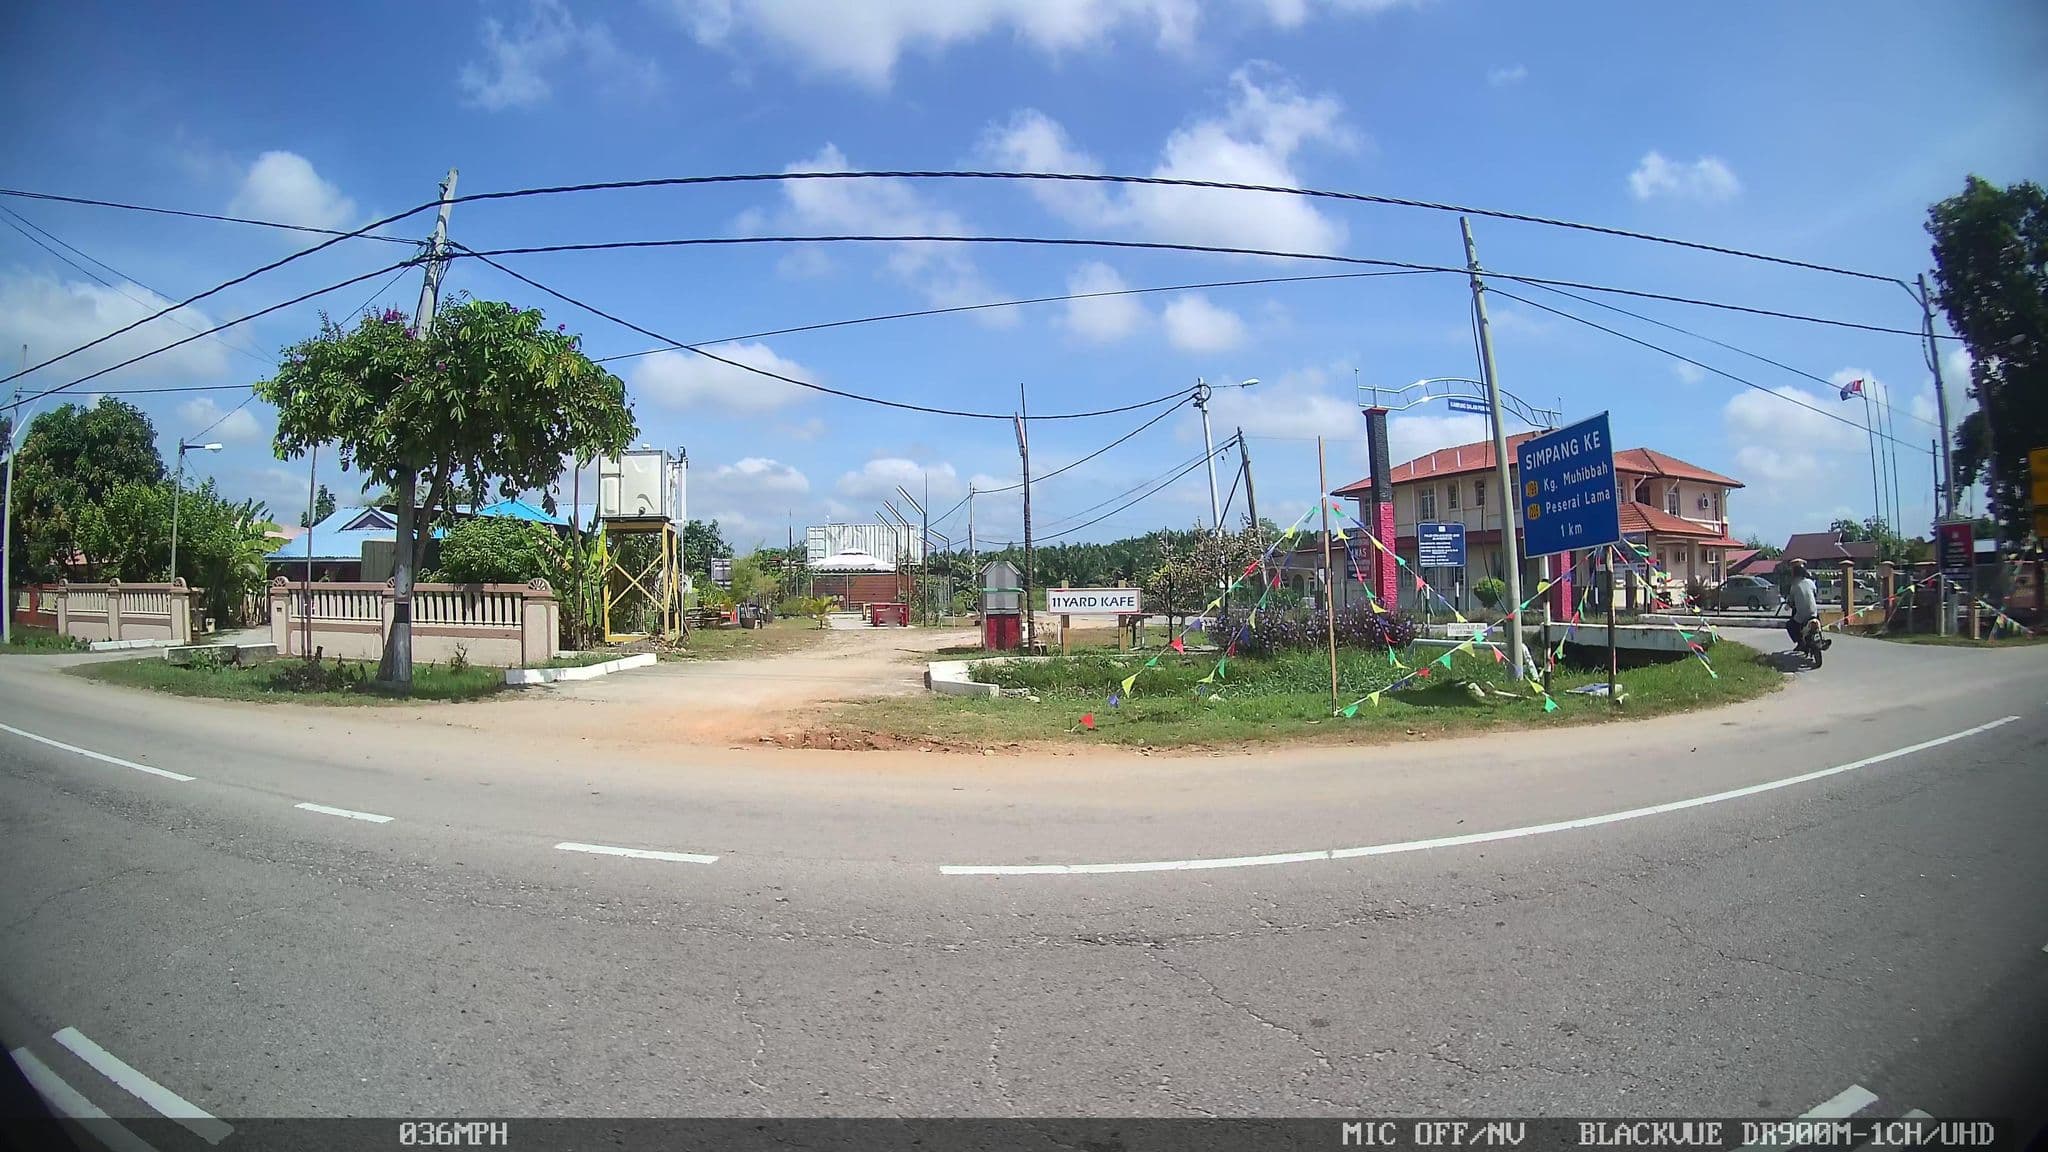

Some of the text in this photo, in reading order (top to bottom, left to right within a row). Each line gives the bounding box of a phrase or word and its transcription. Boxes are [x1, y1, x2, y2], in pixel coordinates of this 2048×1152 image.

[1526, 430, 1601, 470] SIMPANG KE
[1543, 477, 1558, 493] Kg.
[1563, 461, 1608, 486] Muhibbah
[1546, 494, 1580, 514] Peserai
[1585, 488, 1610, 505] Lama
[1560, 521, 1582, 537] 1 km
[1101, 596, 1135, 607] KAFE
